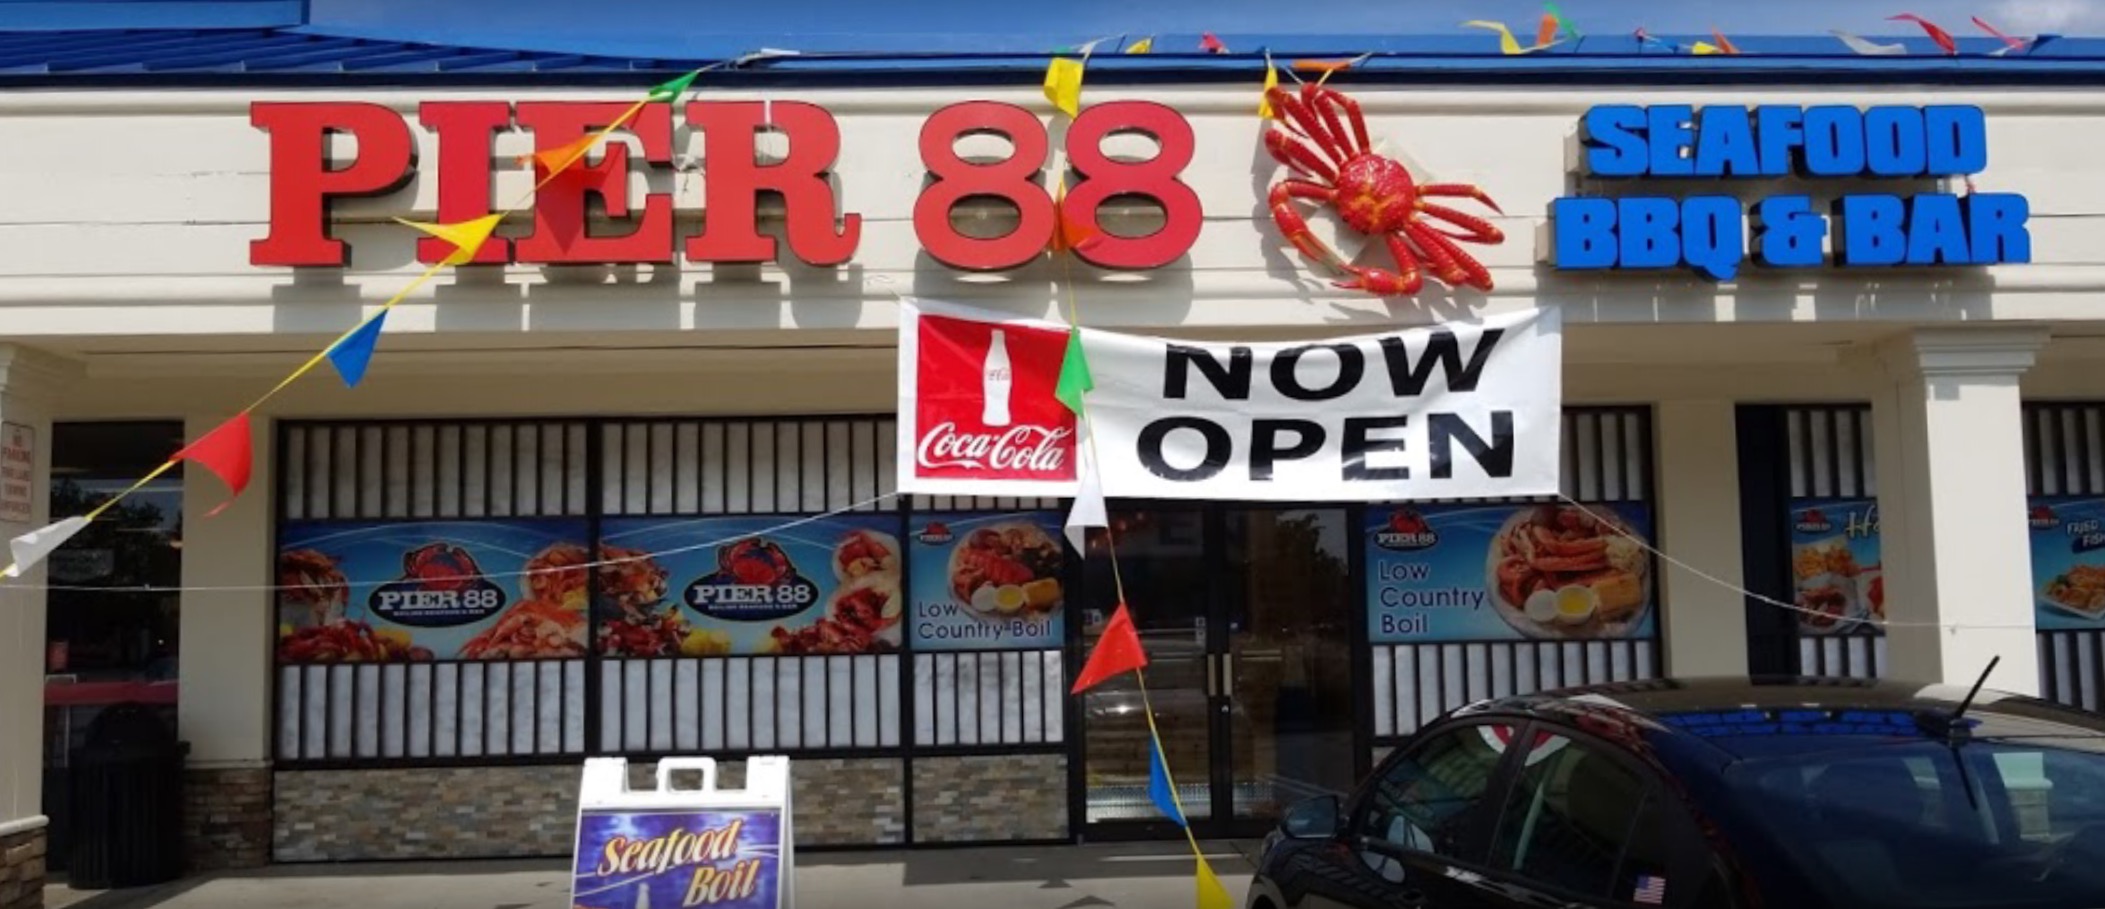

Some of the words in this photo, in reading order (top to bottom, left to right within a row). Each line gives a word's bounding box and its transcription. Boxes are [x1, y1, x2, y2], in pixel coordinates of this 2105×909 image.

[1581, 104, 1988, 179] SEAFOOD
[250, 100, 862, 267] PIER
[913, 100, 1203, 270] 88
[1554, 194, 1744, 280] BBQ
[1757, 194, 1828, 268] &
[1840, 192, 2031, 266] BAR
[1163, 327, 1506, 402] NOW
[917, 421, 1074, 472] Coca-Cola
[1135, 409, 1515, 482] OPEN
[1377, 532, 1417, 544] PIER
[692, 584, 774, 605] PIER
[776, 584, 812, 604] 88
[1378, 561, 1430, 581] Low
[378, 590, 460, 610] PIER
[463, 589, 498, 608] 88
[918, 601, 958, 617] Low
[1380, 587, 1484, 611] Country
[1381, 614, 1428, 634] Boil
[597, 818, 744, 876] Seafood
[682, 858, 762, 908] Boil
